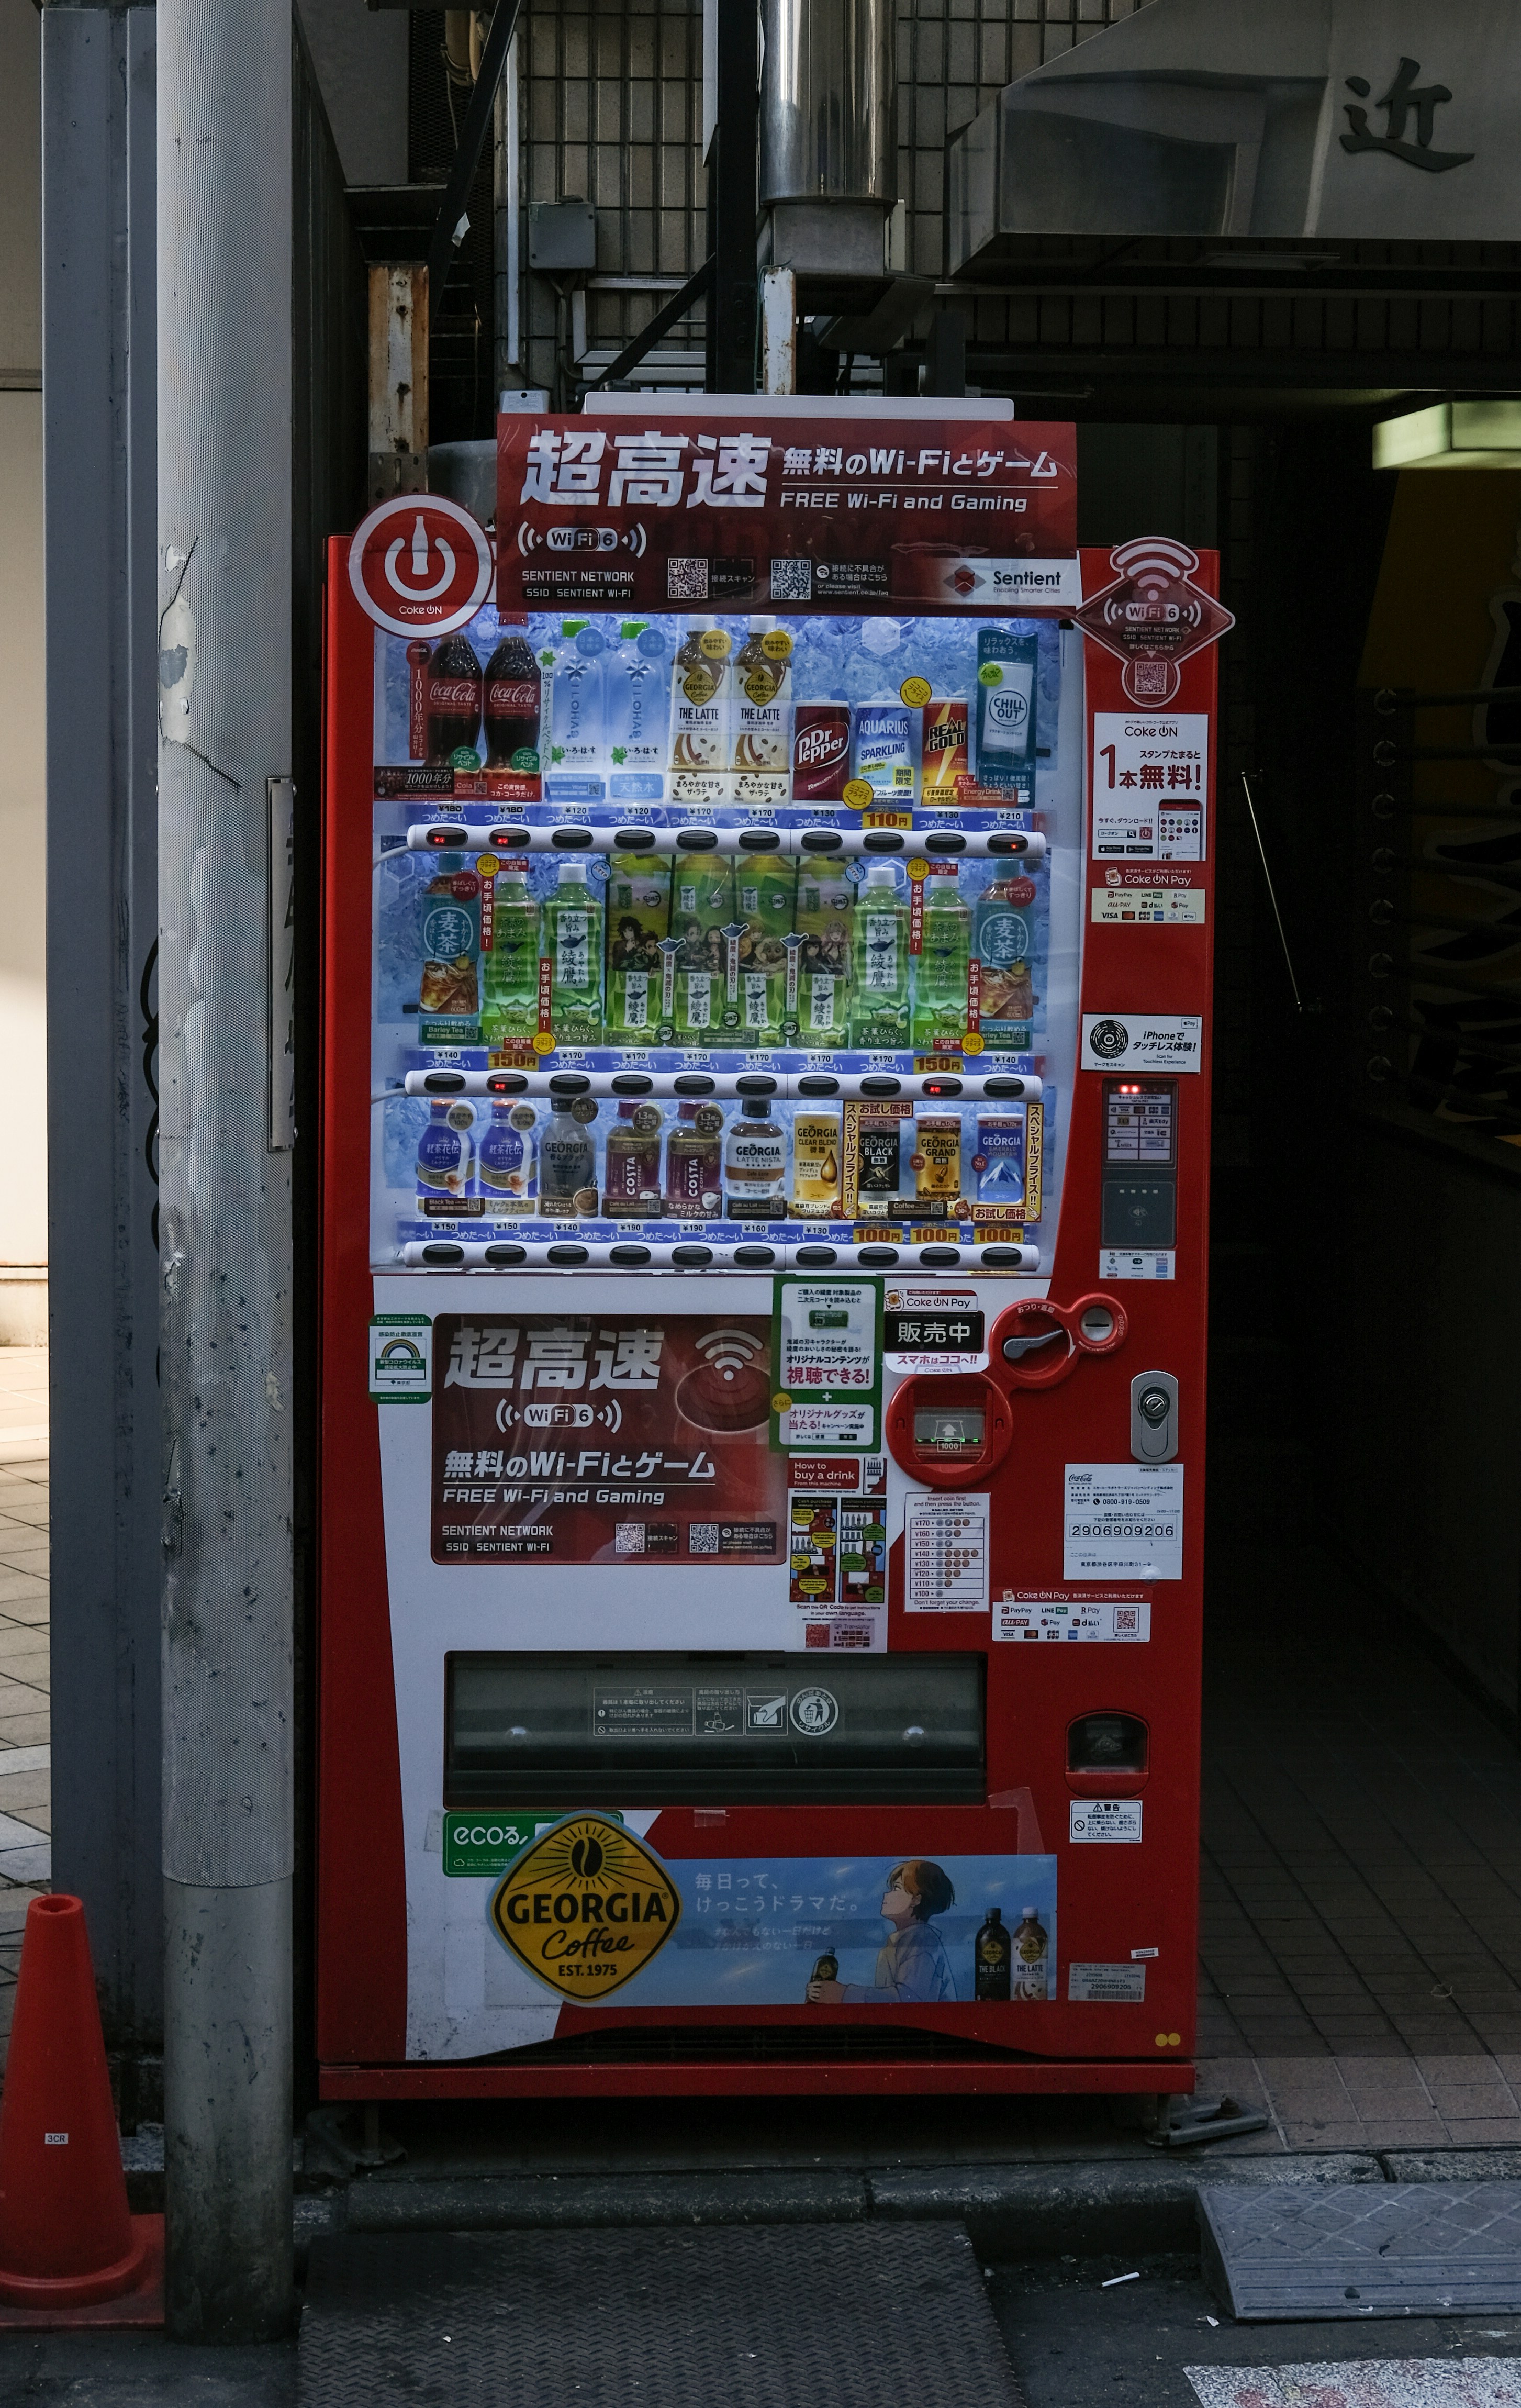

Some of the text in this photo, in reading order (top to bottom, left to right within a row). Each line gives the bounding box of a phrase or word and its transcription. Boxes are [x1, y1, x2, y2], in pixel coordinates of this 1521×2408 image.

[1339, 57, 1476, 173] 近
[520, 430, 773, 508] 超高速
[782, 448, 1059, 479] 無料のWi-Fiとゲーム
[780, 493, 1027, 514] FREE Wi-Fi and Gaming
[522, 571, 634, 582] SENTIENT NETWORK
[993, 572, 1060, 585] Sentient
[608, 589, 631, 598] WI-FI
[430, 682, 477, 701] Coca-Cola
[994, 698, 1024, 710] CHILL
[679, 708, 719, 720] THE LATTE
[741, 708, 780, 720] THE LATTE
[998, 709, 1020, 719] OUT
[859, 720, 908, 735] AQUARIUS
[929, 717, 964, 740] REAL
[811, 729, 833, 745] Dr
[929, 732, 965, 752] GOLD
[798, 737, 844, 764] Pepper
[861, 742, 905, 760] SPARKLING
[1140, 750, 1201, 759] スタンプたまると
[867, 813, 908, 827] 110円
[1125, 875, 1151, 884] Coke
[1171, 875, 1191, 887] Pay
[436, 912, 460, 953] 麦茶
[994, 918, 1016, 958] 麦茶
[561, 951, 577, 985] 綾鷹
[859, 1036, 905, 1046] 香り立つ旨み
[1143, 1031, 1184, 1040] iPhoneで
[1133, 1042, 1196, 1052] タッチレス体験!
[491, 1054, 536, 1066] 150円
[916, 1057, 960, 1071] 150円
[859, 1103, 911, 1115] お試し価格
[427, 1144, 460, 1154] 紅茶花伝
[864, 1147, 893, 1156] BLACK
[926, 1148, 956, 1156] GRAND
[627, 1156, 636, 1195] COSTA
[688, 1158, 698, 1197] COSTA
[680, 1210, 719, 1218] ミルクの甘み
[975, 1208, 1026, 1219] お試し価格
[855, 1229, 900, 1242] 100円
[913, 1228, 957, 1241] 100円
[907, 1298, 932, 1307] Coke
[951, 1299, 970, 1308] Pay
[898, 1322, 970, 1343] 販売中
[444, 1328, 665, 1391] 超高速
[787, 1367, 869, 1384] 視聴できる!
[789, 1410, 865, 1419] オリジナルグッズが
[788, 1420, 821, 1430] 当たる!
[445, 1449, 716, 1479] 無料のWi-Fiとゲーム
[794, 1471, 815, 1481] buy
[826, 1471, 855, 1480] drink
[442, 1489, 665, 1506] FREE Wi-Fi and Gaming
[442, 1525, 553, 1537] SENTIENT NETWORK
[1072, 1526, 1173, 1536] 2906909206
[695, 1873, 778, 1891] 毎日って、
[697, 1894, 857, 1913] けっこうドラマだ。
[558, 1964, 617, 1977] EST. 1975
